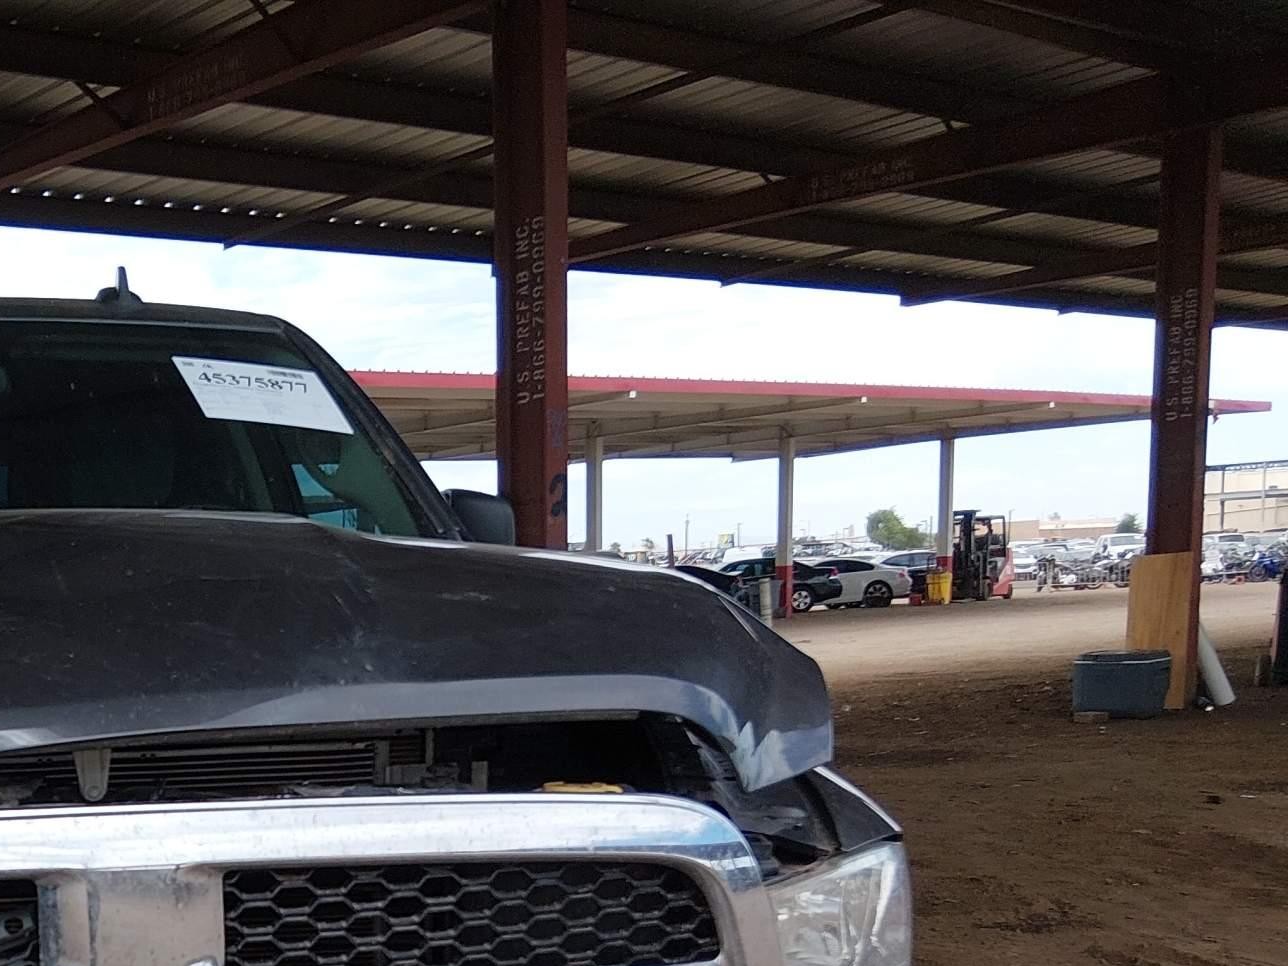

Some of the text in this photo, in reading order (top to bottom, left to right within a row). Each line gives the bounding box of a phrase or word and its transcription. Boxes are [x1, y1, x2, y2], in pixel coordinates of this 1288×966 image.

[515, 216, 530, 260] INC.
[515, 271, 530, 353] PREFAB
[1166, 326, 1182, 384] PREFAB
[198, 372, 307, 393] 45375877
